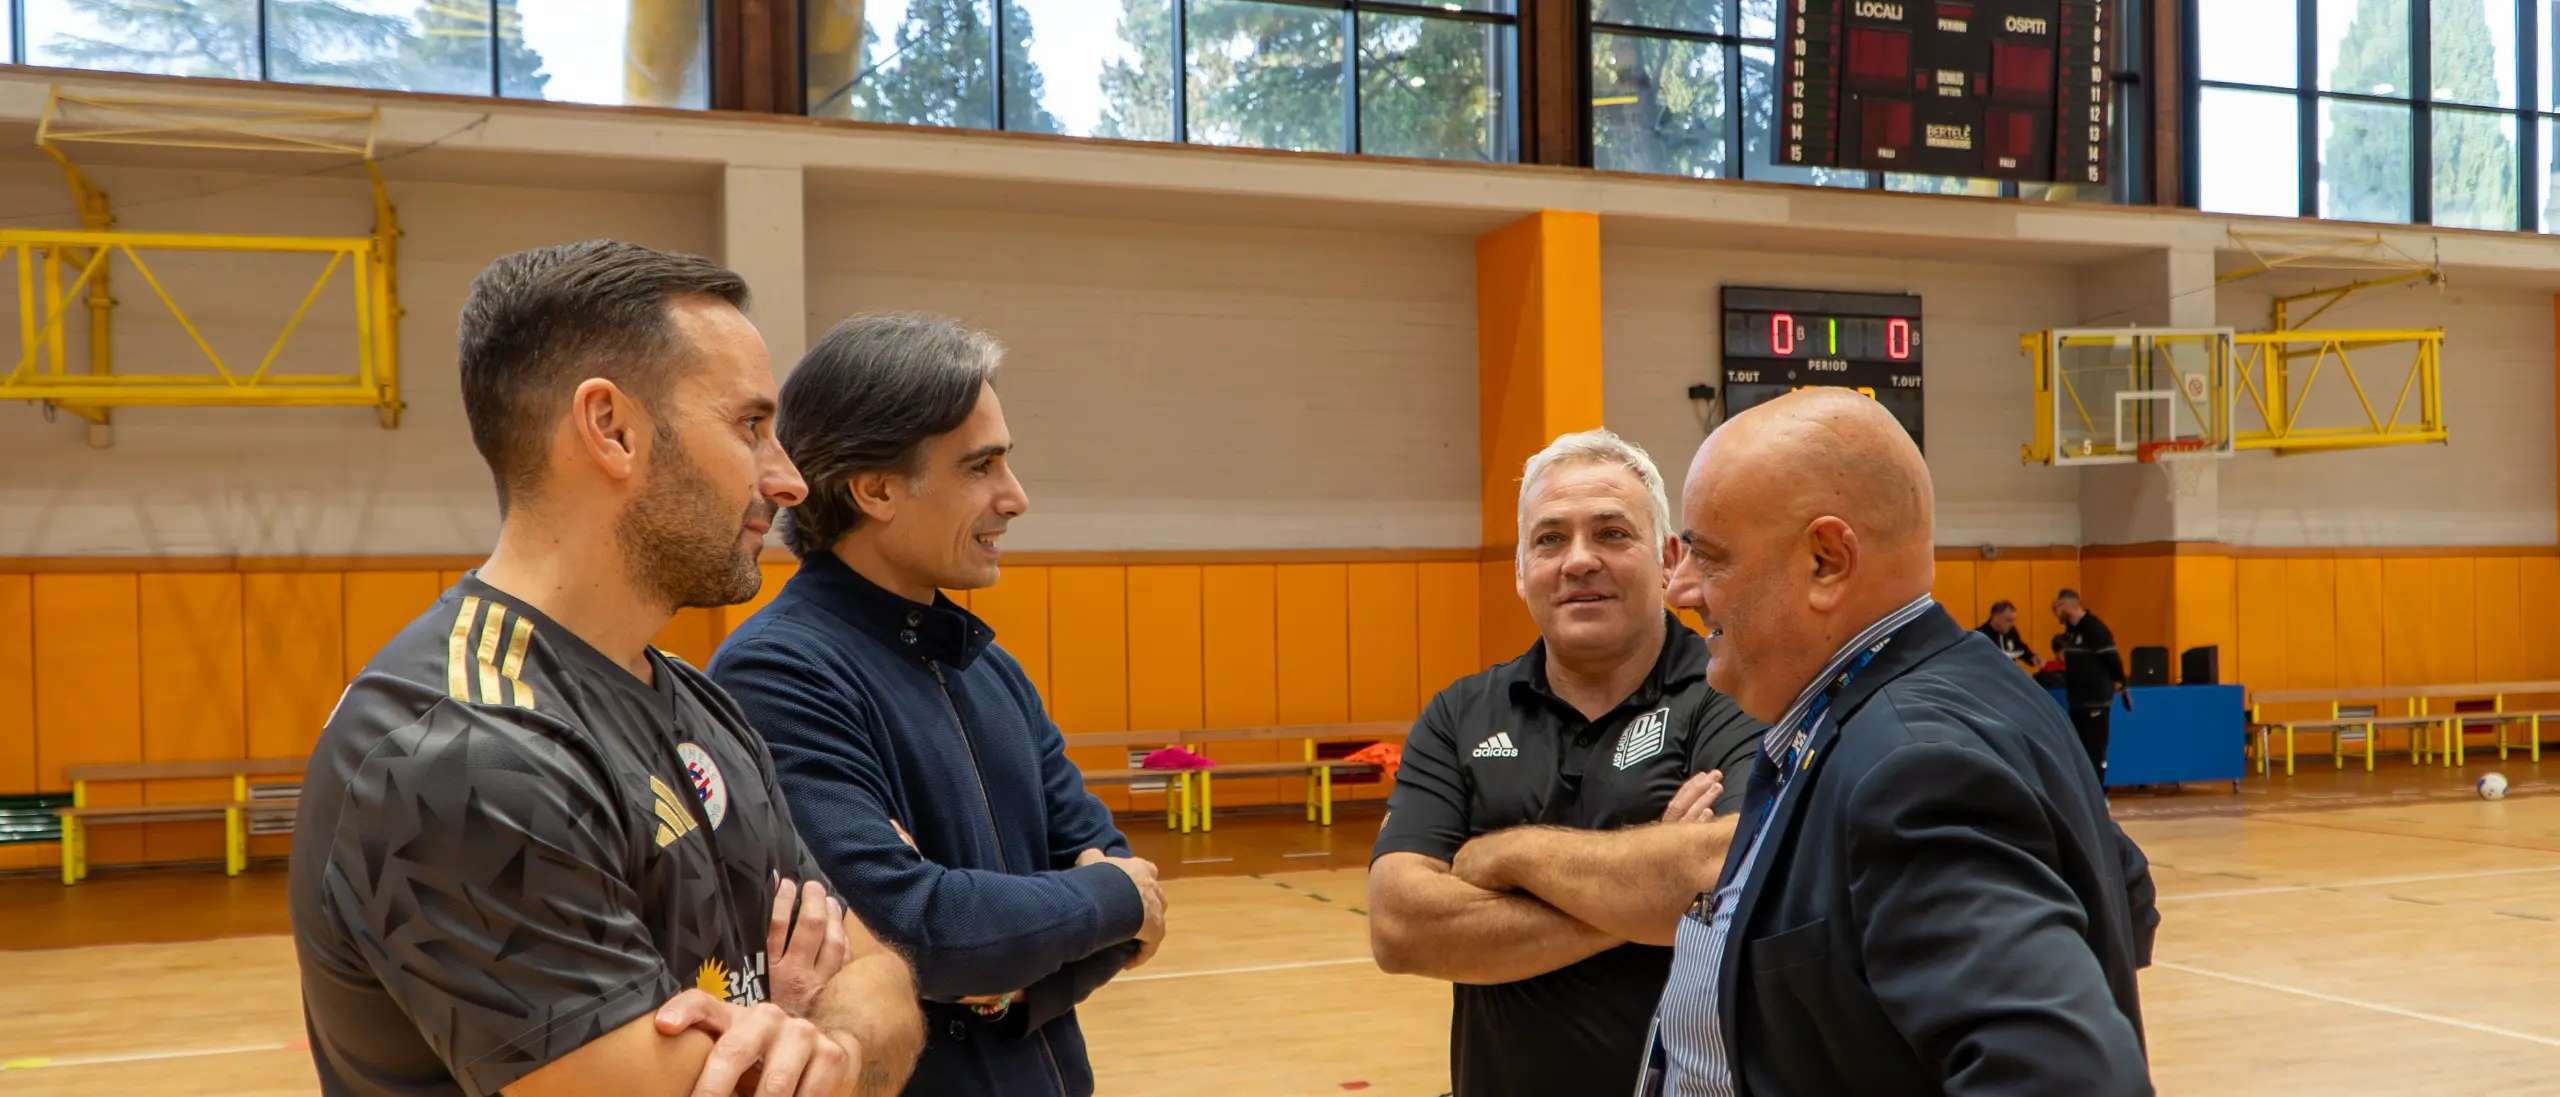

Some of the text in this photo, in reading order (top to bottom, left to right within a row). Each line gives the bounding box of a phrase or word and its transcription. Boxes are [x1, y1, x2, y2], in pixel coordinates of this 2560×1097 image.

[1855, 1, 1903, 20] LOCALI
[2095, 5, 2102, 22] 7
[1796, 17, 1805, 34] 9
[2005, 15, 2046, 35] OSPITI
[1794, 38, 1806, 56] 10
[1794, 59, 1804, 77] 11
[2091, 65, 2102, 83] 10
[1792, 81, 1805, 98] 12
[2091, 85, 2101, 103] 11
[1791, 102, 1804, 120] 13
[2089, 105, 2101, 122] 12
[1791, 123, 1803, 140] 14
[2089, 125, 2100, 142] 13
[1790, 144, 1803, 162] 15
[2088, 145, 2099, 162] 14
[2088, 165, 2099, 182] 15
[1772, 313, 1794, 355] 0
[1796, 325, 1805, 341] B
[1829, 318, 1837, 355] 1
[1888, 318, 1909, 359] 0
[1912, 331, 1921, 346] B
[1808, 360, 1848, 372] PERIOD
[1728, 370, 1760, 383] T.OUT
[1891, 375, 1921, 388] T.OUT
[1472, 747, 1519, 758] adidas
